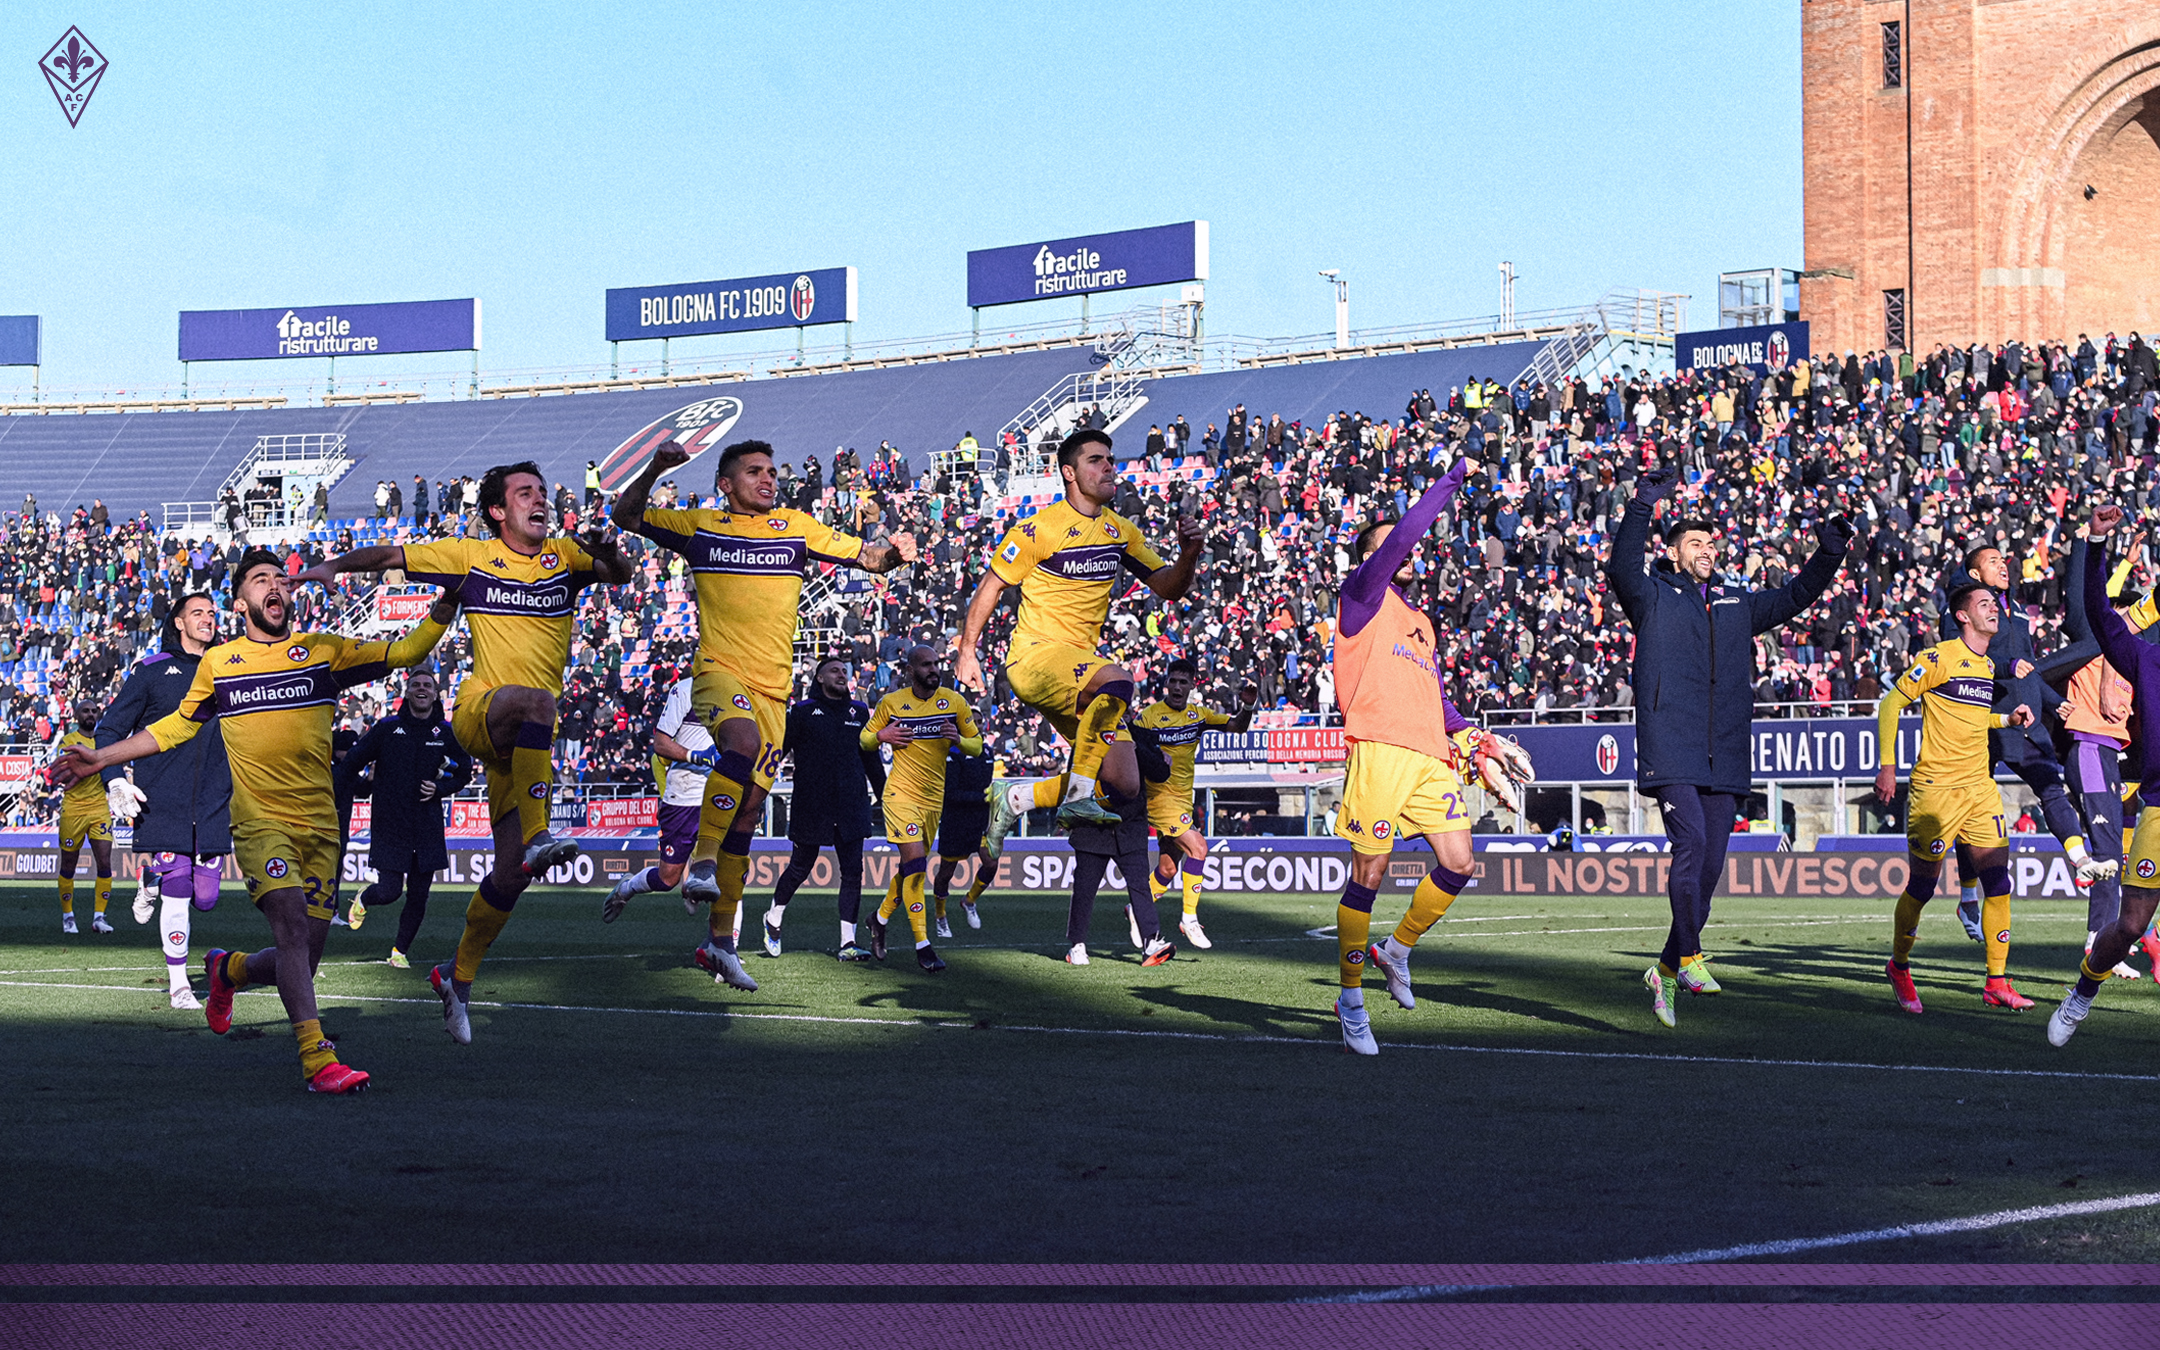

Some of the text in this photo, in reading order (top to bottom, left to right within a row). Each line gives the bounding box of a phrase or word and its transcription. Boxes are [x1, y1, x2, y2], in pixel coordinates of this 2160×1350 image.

[1033, 245, 1100, 276] facile
[1035, 269, 1127, 294] ristrutturare
[640, 286, 786, 326] BOLOGNA FC 1909
[277, 310, 350, 338] facile
[279, 336, 379, 354] ristrutturare
[1751, 342, 1763, 356] FC
[675, 400, 734, 422] BFC
[709, 547, 790, 566] Mediacom
[1062, 559, 1118, 574] Mediacom
[486, 587, 564, 607] Mediacom
[229, 683, 310, 706] Mediacom
[1203, 731, 1344, 749] CENTRO BOLOGNA CLUB
[5, 761, 31, 776] COSTA
[756, 741, 782, 778] 18
[602, 802, 628, 816] GRUPPO
[629, 801, 641, 815] DEL
[16, 854, 58, 873] GOLDBET
[1202, 855, 1352, 891] SECOND
[1391, 863, 1424, 875] DIRETTA
[1502, 857, 1536, 892] IL
[1547, 857, 1673, 893] NOSTR
